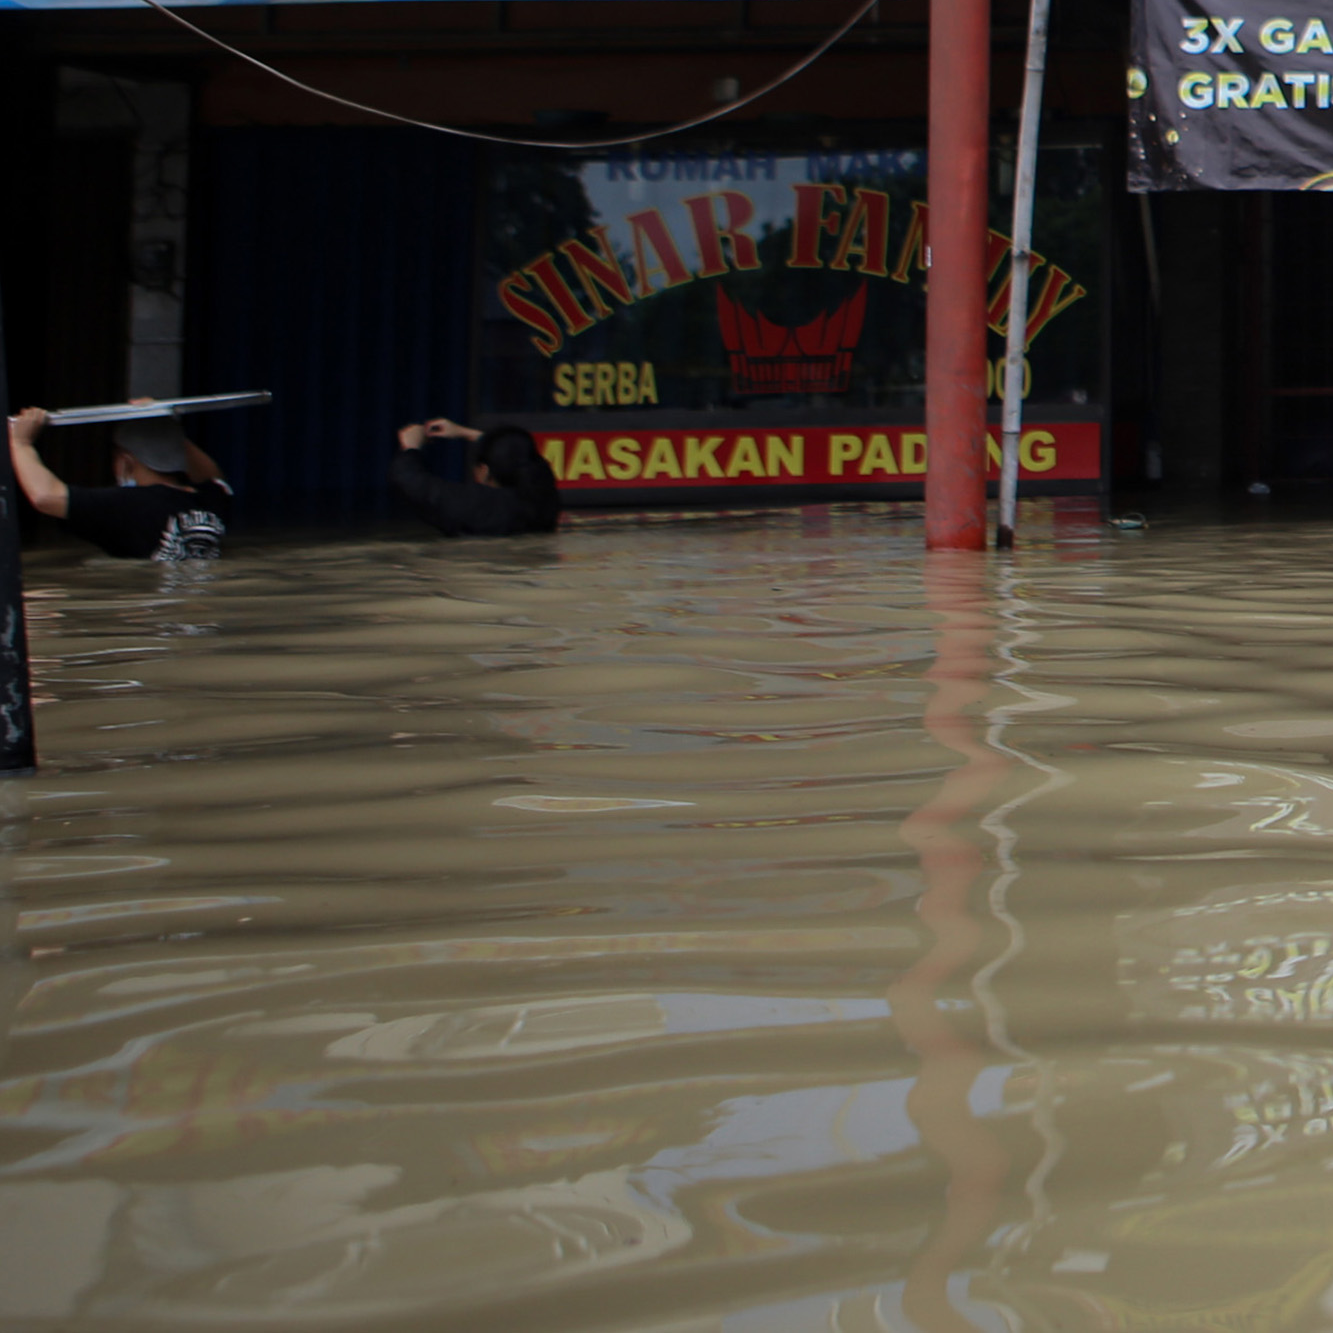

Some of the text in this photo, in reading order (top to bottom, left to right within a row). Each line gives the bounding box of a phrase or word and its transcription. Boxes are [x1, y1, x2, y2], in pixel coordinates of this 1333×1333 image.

[1179, 17, 1244, 55] 3X
[606, 149, 777, 182] RUMAH
[498, 189, 762, 358] SINAR
[552, 360, 660, 407] SERBA
[827, 429, 1057, 478] PADG
